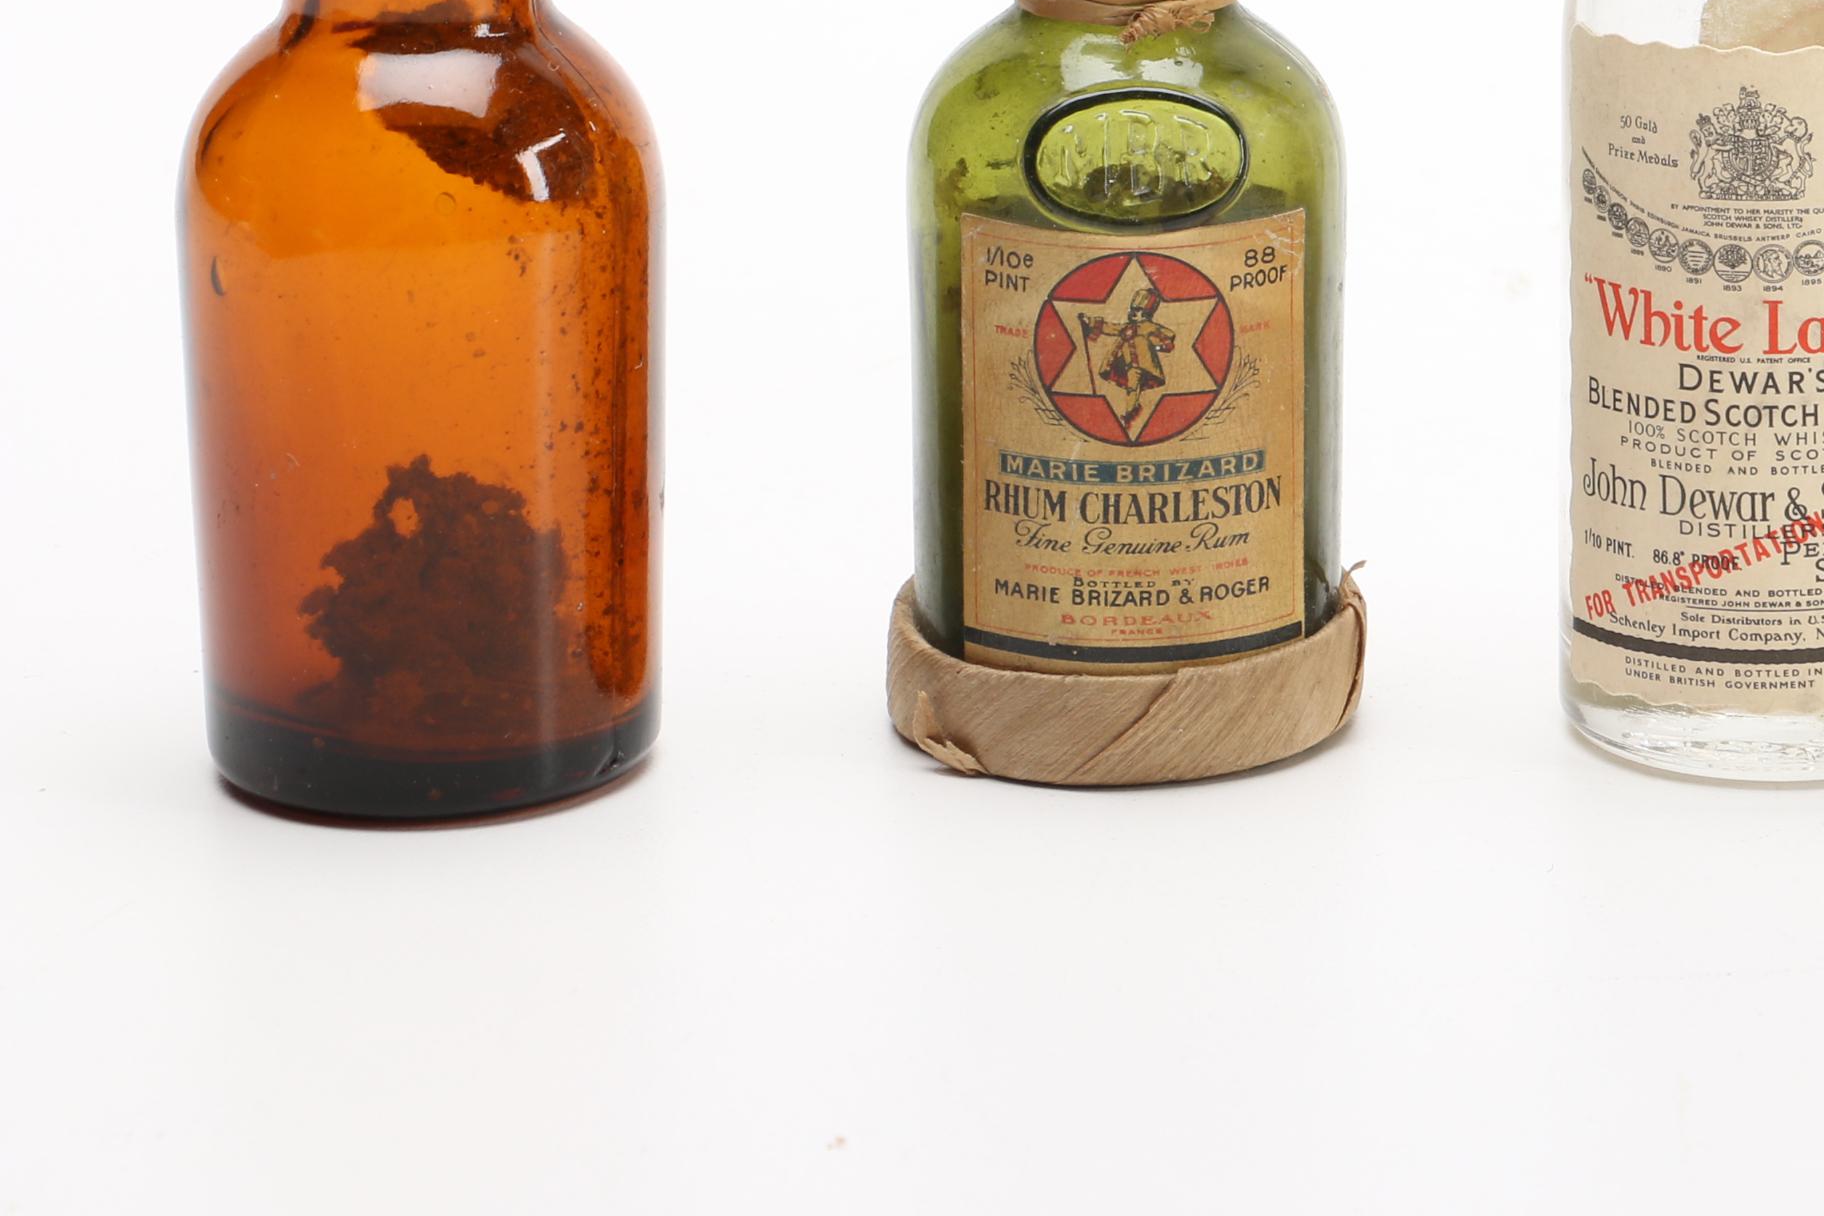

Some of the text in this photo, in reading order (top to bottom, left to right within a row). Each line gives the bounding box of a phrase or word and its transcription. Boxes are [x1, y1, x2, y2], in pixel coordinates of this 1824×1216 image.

[1620, 115, 1658, 134] 50 Gold
[1632, 136, 1646, 145] and
[1608, 143, 1679, 168] Prize Medals
[1682, 205, 1731, 214] APPOINTMENT
[1796, 228, 1822, 238] CAIRO
[1244, 246, 1276, 267] 88
[984, 270, 1030, 292] PINT
[1230, 265, 1287, 292] PROOF
[1723, 284, 1742, 292] 1893
[1801, 278, 1822, 286] 1895
[1697, 355, 1736, 364] REGISTERED
[1588, 375, 1696, 424] BLENDED
[1704, 398, 1819, 428] SCOTCH
[1628, 419, 1665, 440] 100%
[1676, 428, 1757, 447] SCOTCH
[1620, 435, 1718, 460] PRODUCT
[1731, 450, 1757, 461] OF
[1006, 453, 1260, 483] MARIE BRIZARD
[1650, 458, 1712, 474] BLENDED
[1727, 466, 1758, 476] AND
[983, 476, 1283, 525] RHUM CHARLESTON
[1583, 457, 1647, 511] John
[1659, 473, 1775, 523] Dewar
[1784, 487, 1811, 522] &
[1014, 519, 1250, 554] Fine Genuine Rum
[1585, 528, 1602, 549] 1/10
[1024, 564, 1082, 577] PRODUCE
[1088, 569, 1103, 577] OF
[1108, 569, 1161, 577] FRENCH
[1169, 565, 1202, 576] WEST
[994, 576, 1270, 607] MARIE BRIZARD & ROGER
[1073, 577, 1195, 588] BOTTLED BY
[1674, 585, 1727, 597] BLENDED
[1735, 590, 1760, 598] AND
[1768, 588, 1822, 597] BOTTLED
[1585, 589, 1616, 620] FOR
[1659, 594, 1718, 607] REGISTERED
[1721, 599, 1750, 607] JOHN
[1061, 610, 1214, 626] BORDEAUX
[1609, 611, 1666, 638] Schenley
[1672, 623, 1721, 641] Import
[1681, 612, 1705, 622] Sole
[1711, 615, 1782, 626] Distributors
[1789, 617, 1802, 626] in
[1625, 656, 1687, 673] DISTILLED
[1695, 667, 1725, 677] AND
[1734, 669, 1800, 678] BOTTLED
[1808, 667, 1823, 676] IN
[1625, 668, 1662, 682] UNDER
[1669, 676, 1716, 688] BRITISH
[1725, 680, 1815, 690] GOVERNMENT
